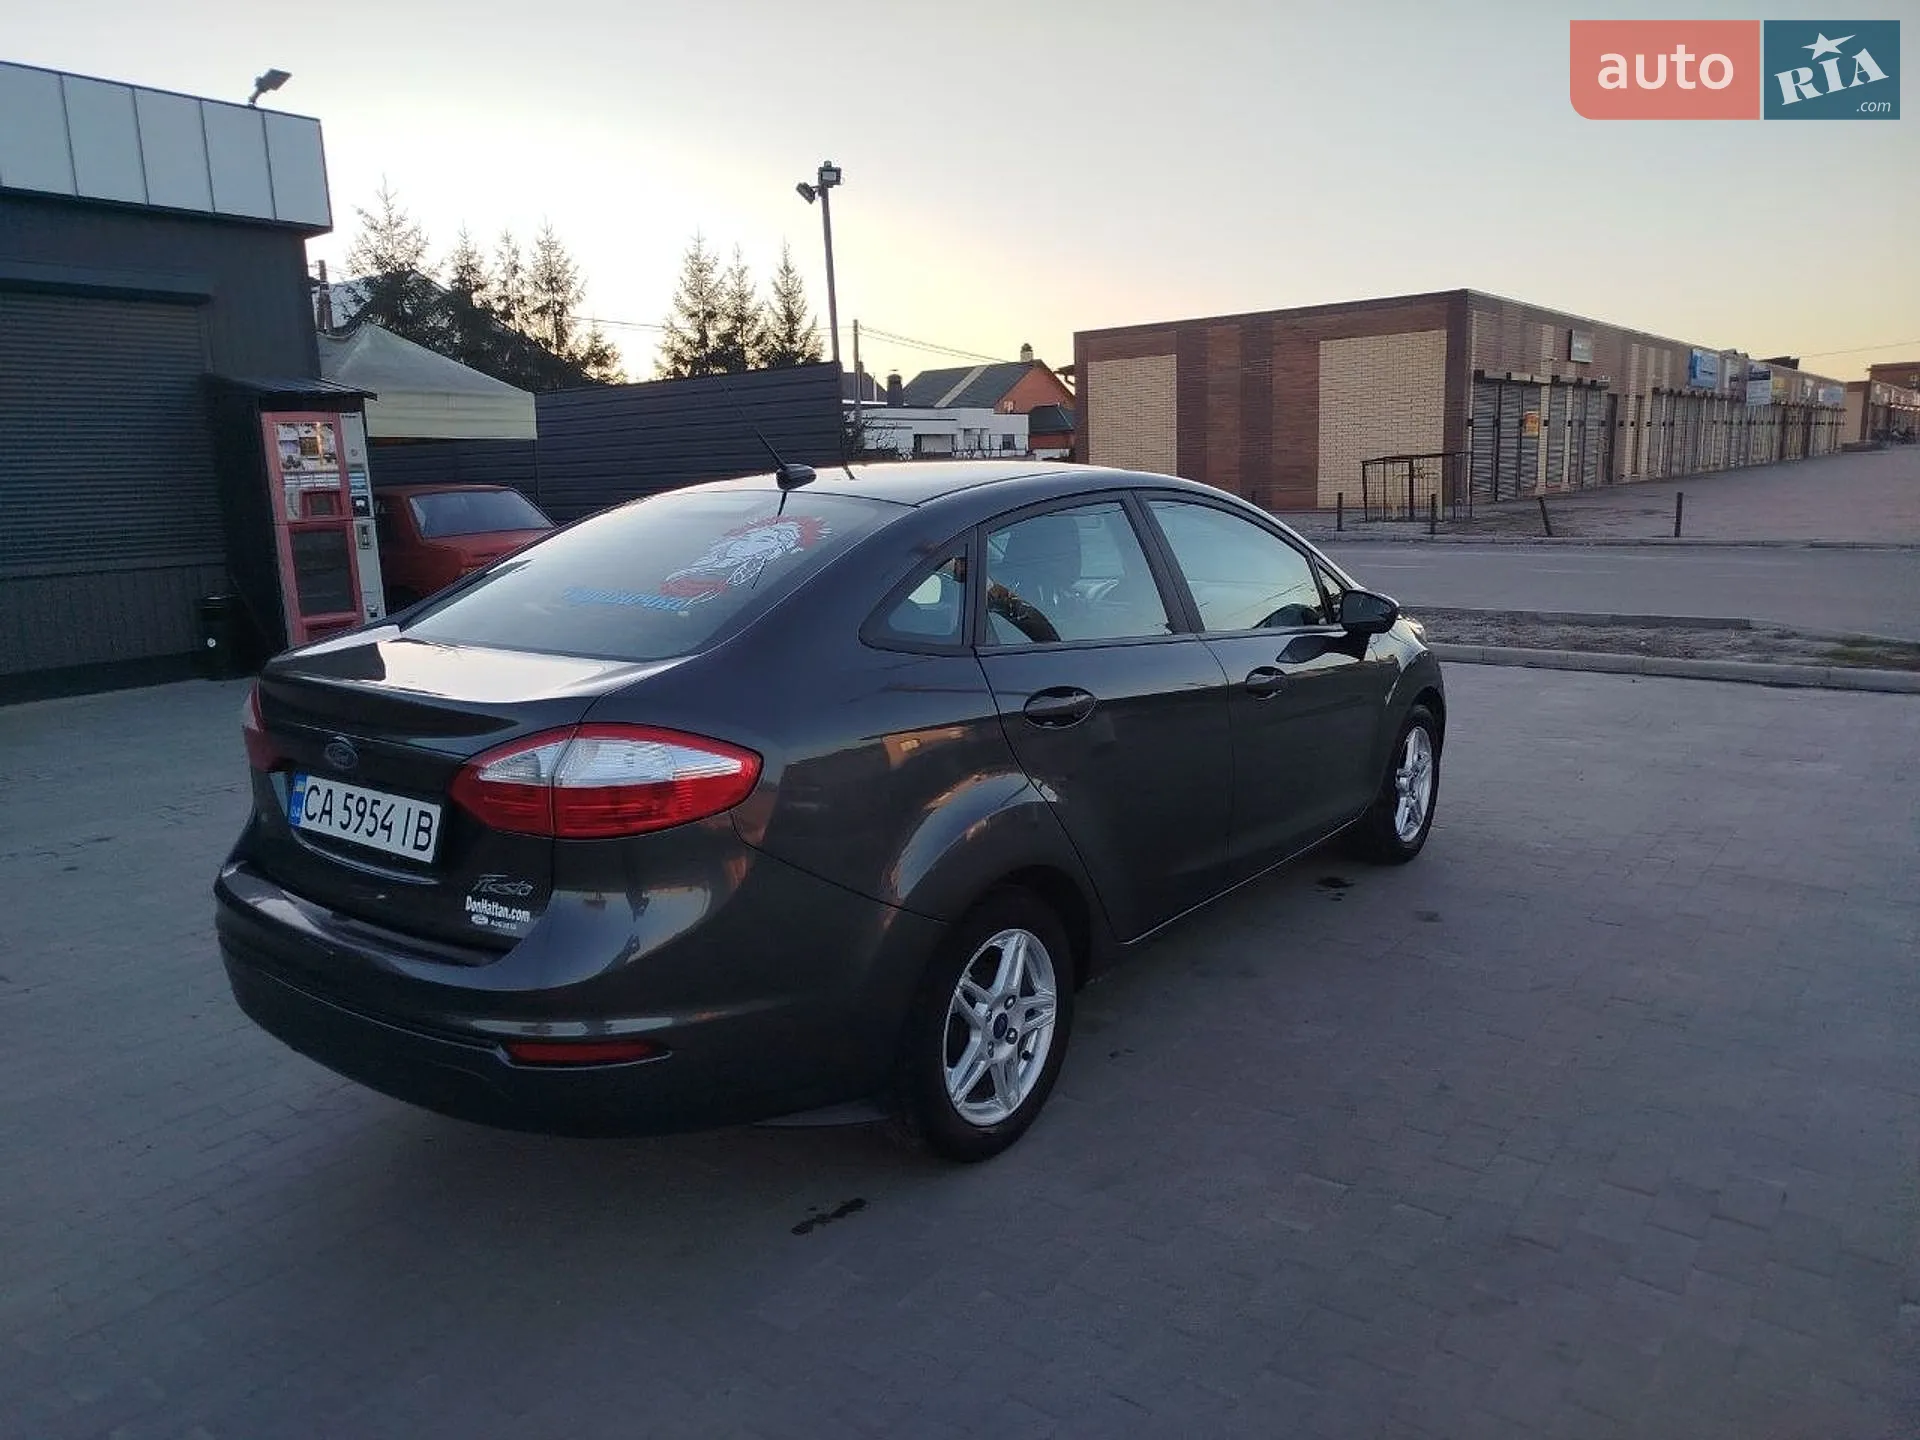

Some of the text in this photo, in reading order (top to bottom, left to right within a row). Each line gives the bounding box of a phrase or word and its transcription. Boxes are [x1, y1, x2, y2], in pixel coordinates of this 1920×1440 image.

[304, 784, 433, 851] CA 5954 IB
